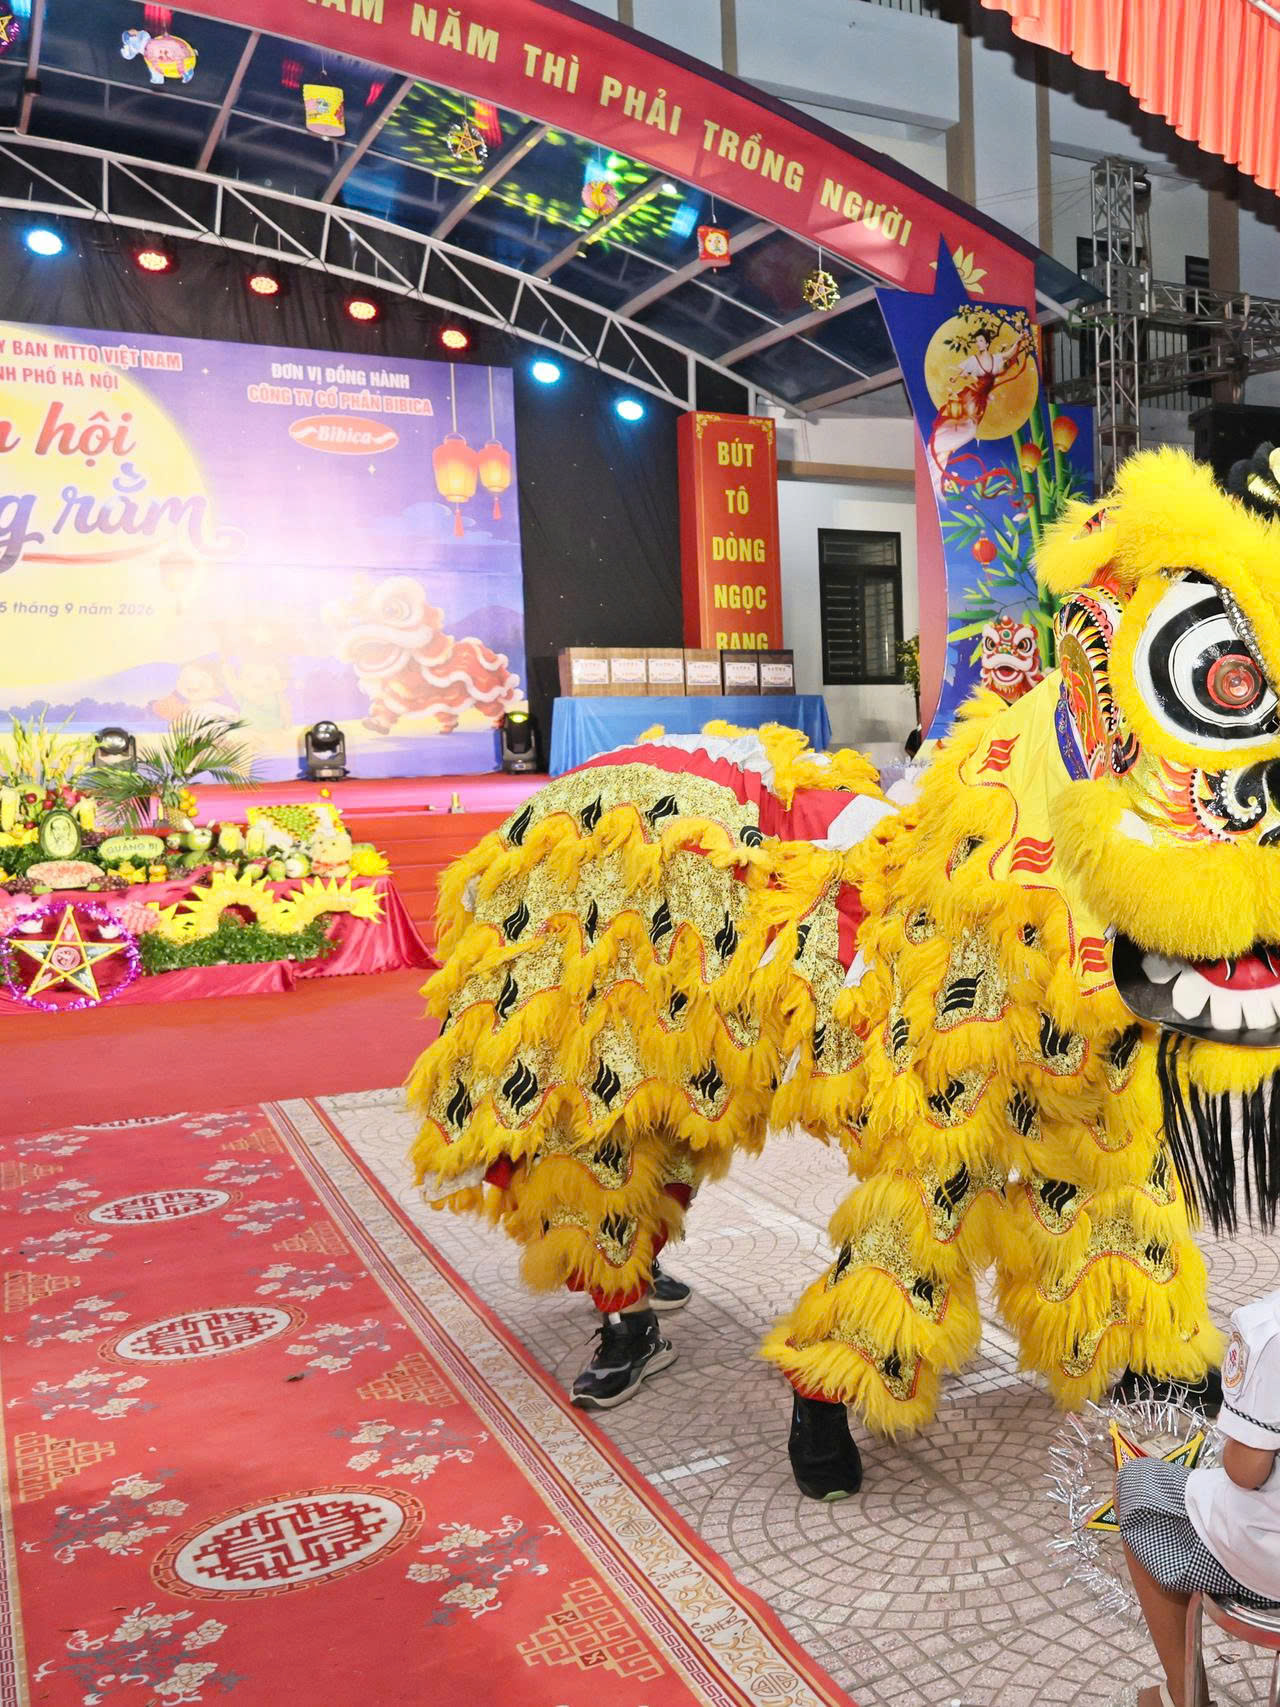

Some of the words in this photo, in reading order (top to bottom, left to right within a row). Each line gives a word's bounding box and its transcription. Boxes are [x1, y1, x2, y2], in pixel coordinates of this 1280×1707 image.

[410, 3, 499, 64] NĂM
[523, 43, 580, 94] THÌ
[600, 75, 682, 136] PHẢI
[703, 119, 804, 193] TRỒNG
[819, 178, 912, 247] NGƯỜI
[13, 340, 48, 358] BAN
[54, 344, 99, 362] MTTQ
[103, 346, 138, 369] VIỆT
[143, 352, 182, 370] NAM
[23, 364, 57, 385] PHỐ
[63, 368, 85, 387] HÀ
[90, 371, 119, 392] NỘI
[271, 363, 304, 381] ĐƠN
[307, 365, 322, 385] VỊ
[370, 369, 410, 389] HÀNH
[247, 383, 293, 405] CÔNG
[294, 388, 314, 407] TY
[383, 396, 434, 416] BIBICA
[35, 401, 137, 467] hội
[317, 425, 373, 445] Bibica
[717, 437, 754, 468] BÚT
[52, 462, 240, 552] rằm
[725, 485, 749, 515] TÔ
[712, 530, 766, 563] DÒNG
[13, 601, 59, 618] tháng
[64, 602, 74, 613] 9
[78, 602, 113, 615] năm
[714, 584, 767, 615] NGỌC
